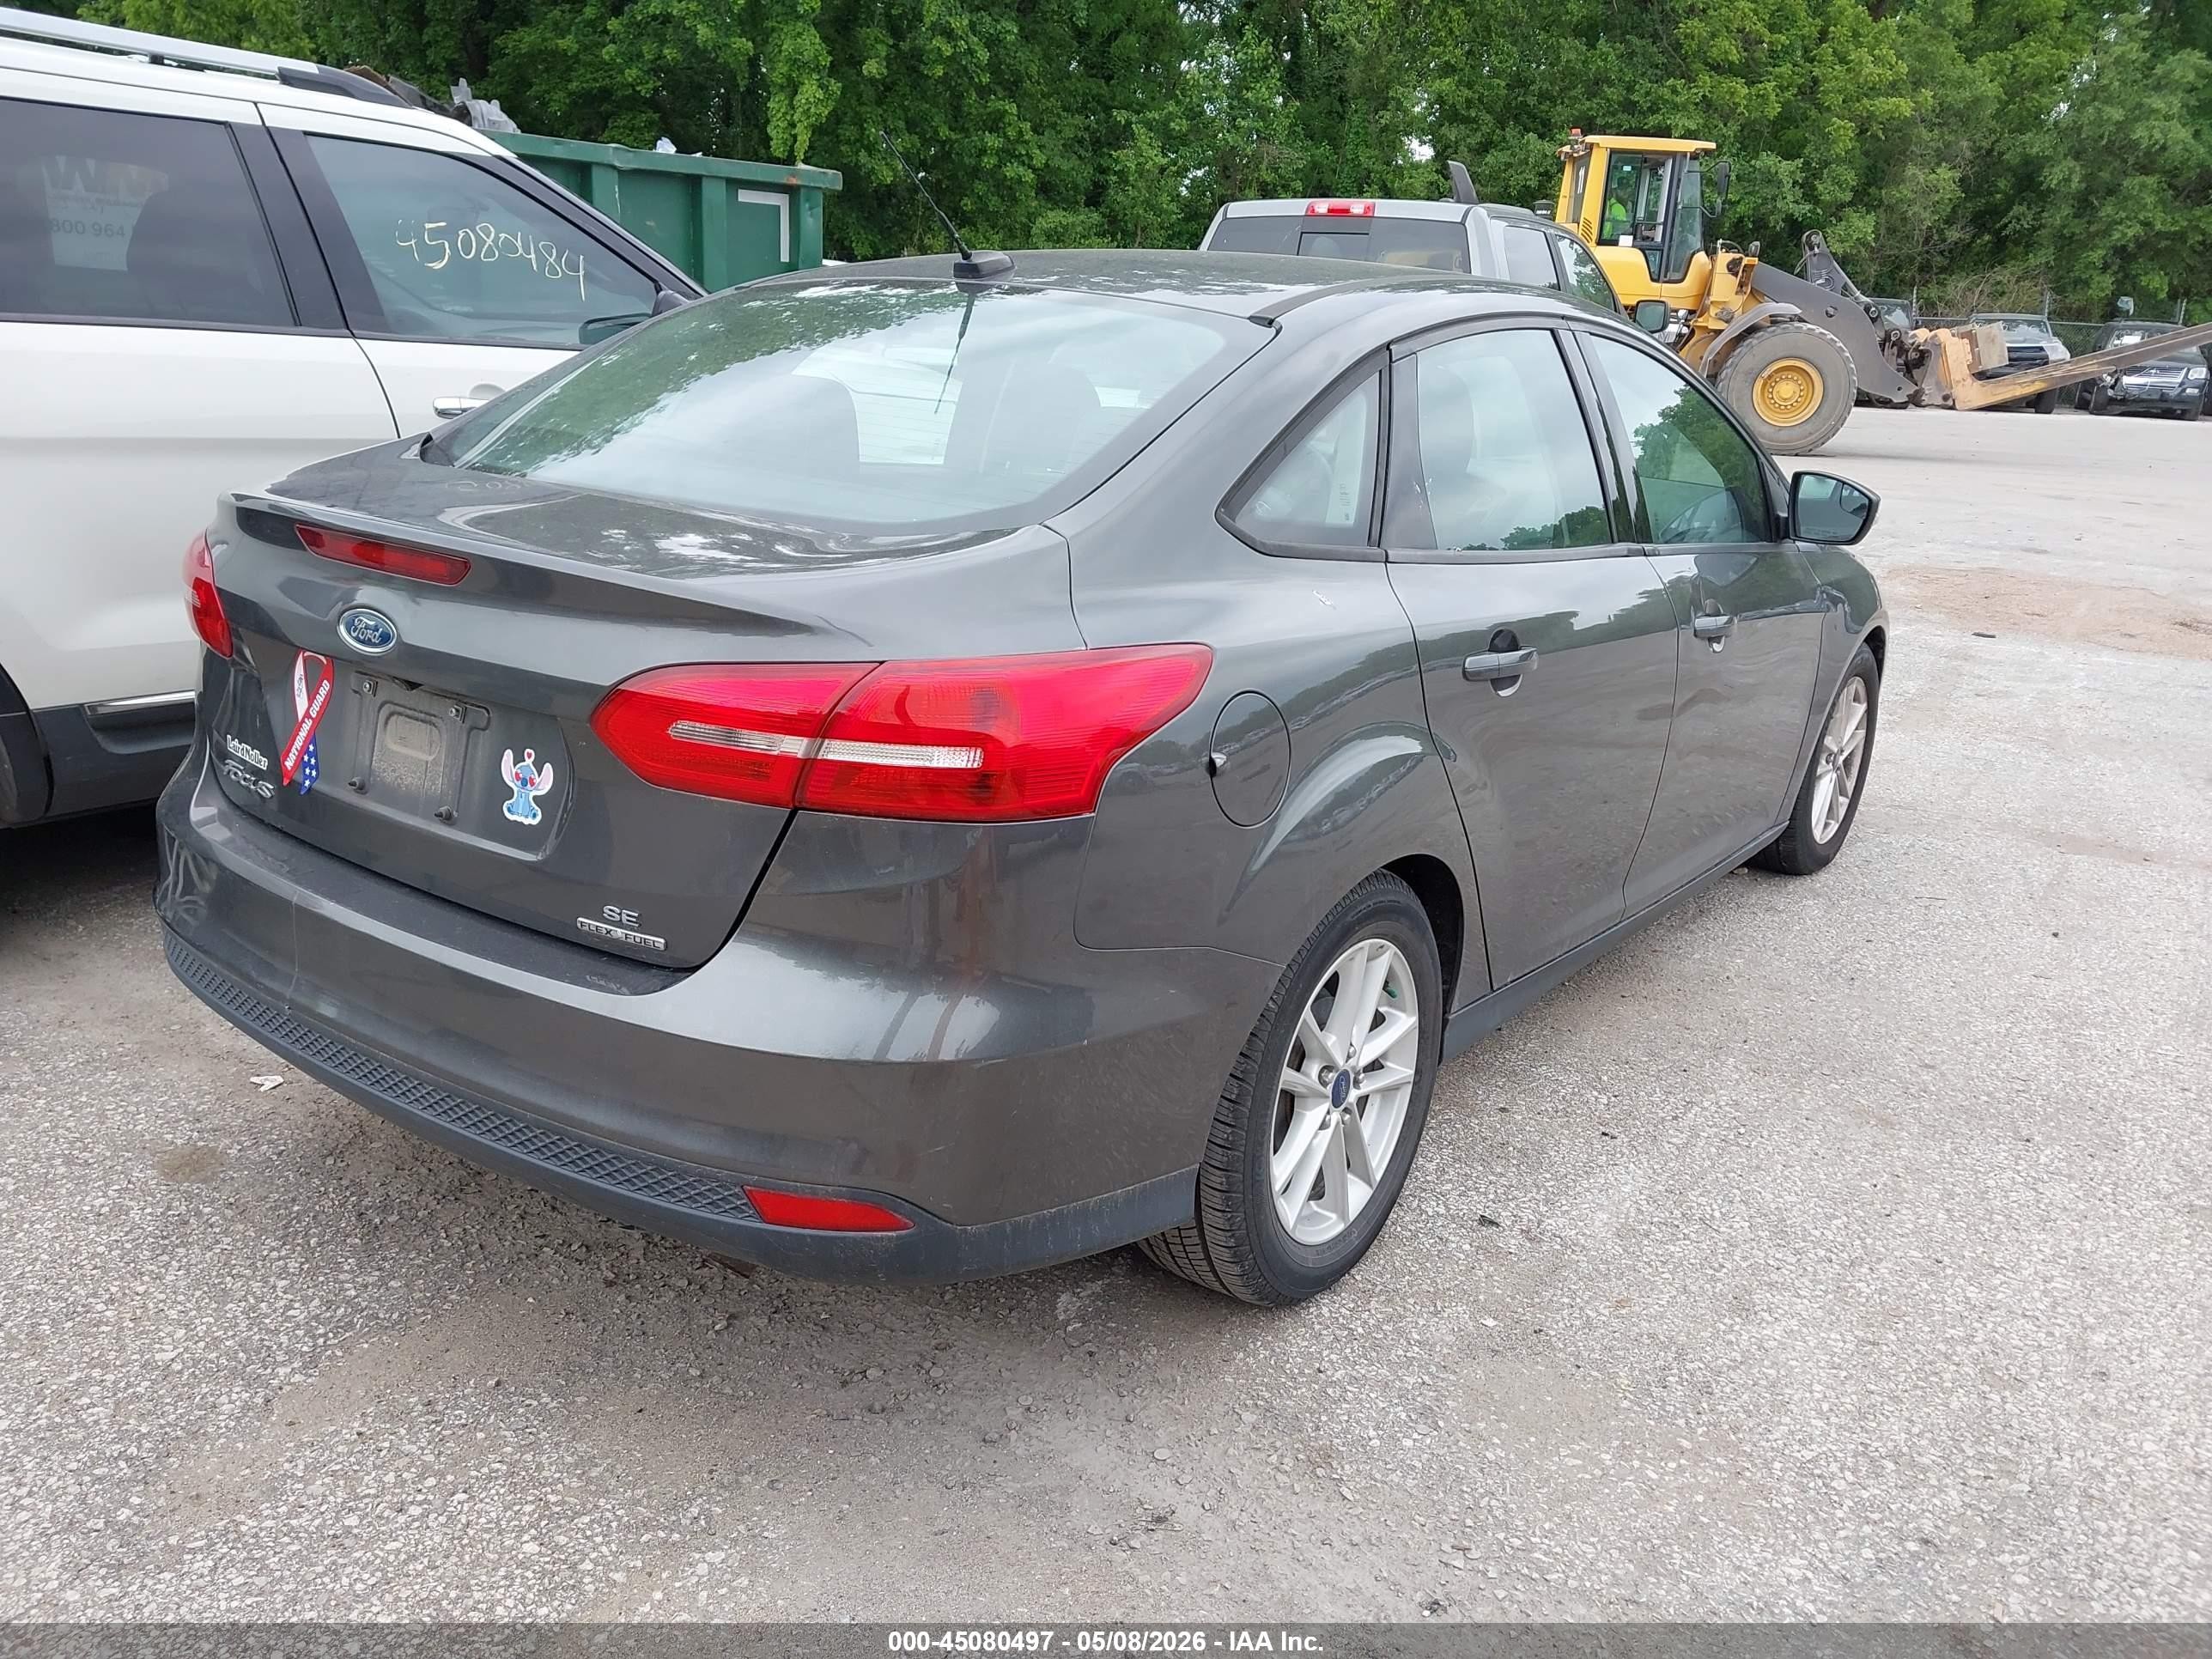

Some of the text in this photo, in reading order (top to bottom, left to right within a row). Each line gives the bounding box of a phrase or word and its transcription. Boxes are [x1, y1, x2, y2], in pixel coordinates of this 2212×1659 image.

[91, 221, 125, 238] 964
[395, 219, 585, 301] 45080484
[350, 617, 383, 643] Ford
[284, 679, 331, 770] NATIONAL GUARD
[603, 905, 640, 927] SE
[580, 921, 663, 949] FLEX FUEL
